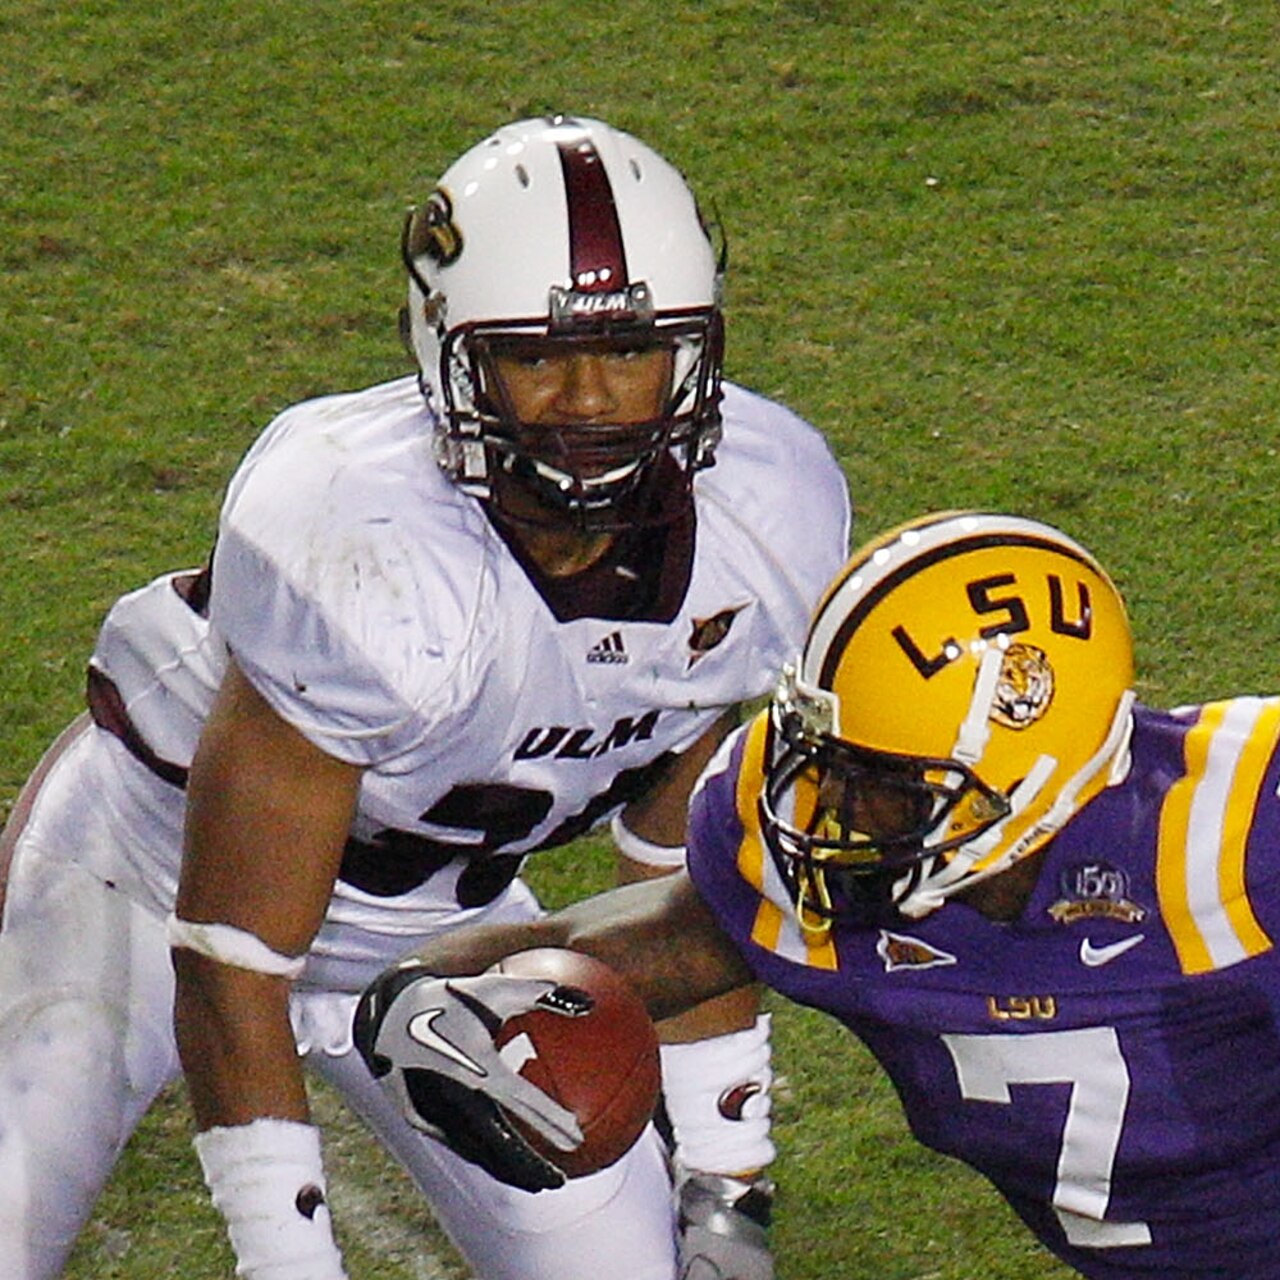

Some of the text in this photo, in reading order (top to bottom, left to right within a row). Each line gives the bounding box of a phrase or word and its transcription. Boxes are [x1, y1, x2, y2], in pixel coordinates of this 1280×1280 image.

[571, 292, 627, 312] ULM
[891, 574, 1091, 679] LSU
[513, 709, 662, 761] ULM
[987, 994, 1058, 1020] LSU
[940, 1027, 1152, 1249] 7
